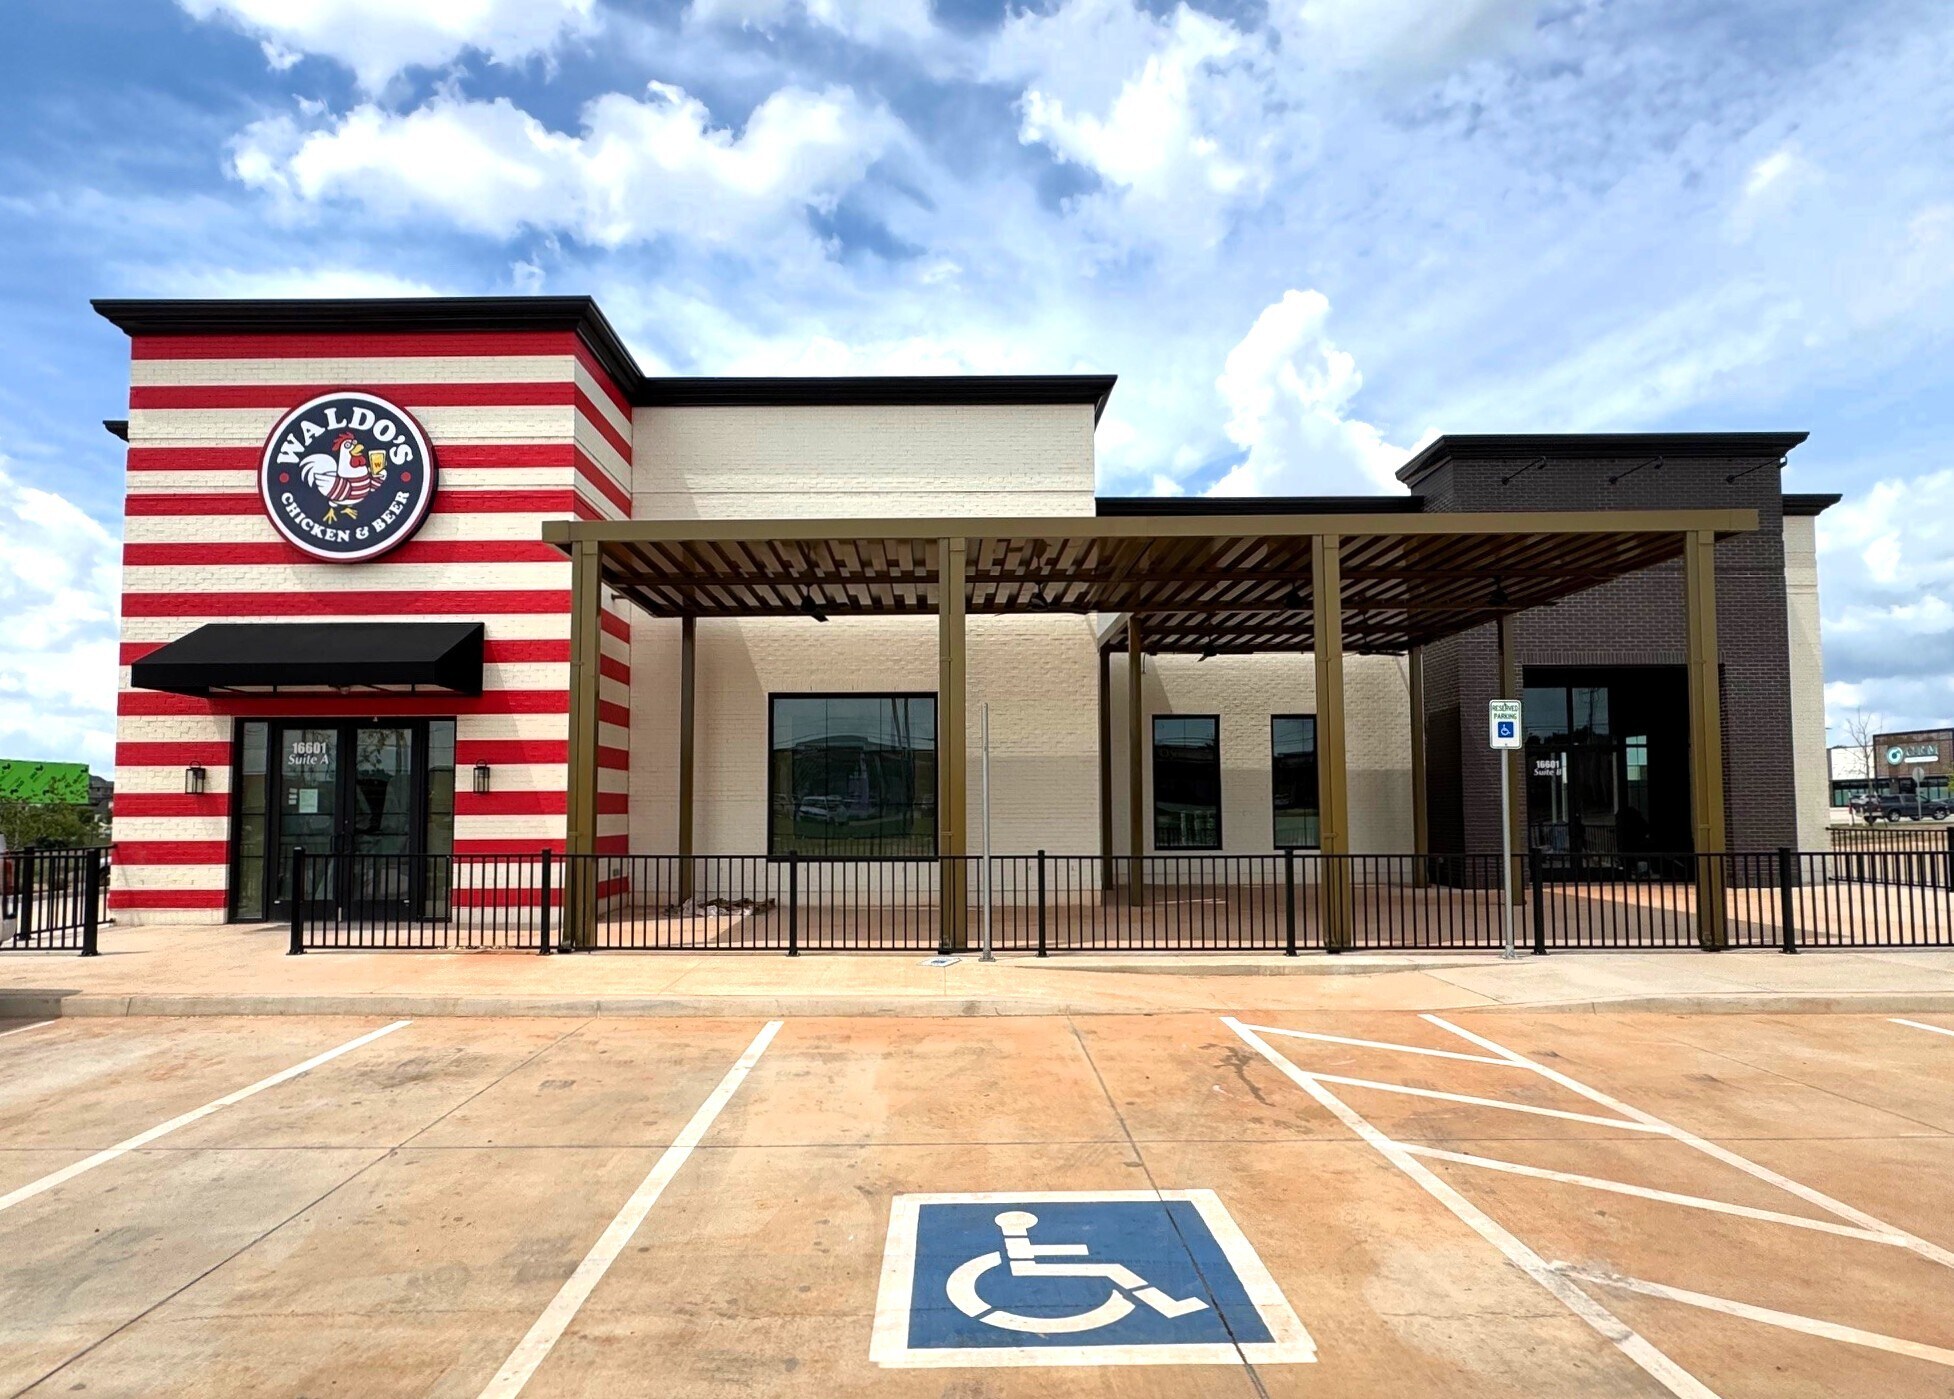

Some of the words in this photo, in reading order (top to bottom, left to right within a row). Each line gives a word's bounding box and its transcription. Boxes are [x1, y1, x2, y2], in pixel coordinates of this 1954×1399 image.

[277, 407, 413, 465] WALDO'S
[281, 492, 350, 542] CHICKEN
[355, 526, 369, 539] &
[372, 491, 410, 532] BEER
[292, 742, 327, 753] 16601
[288, 754, 317, 765] Suite
[320, 754, 329, 764] A
[1536, 760, 1559, 768] 16601
[1534, 768, 1555, 776] Suite
